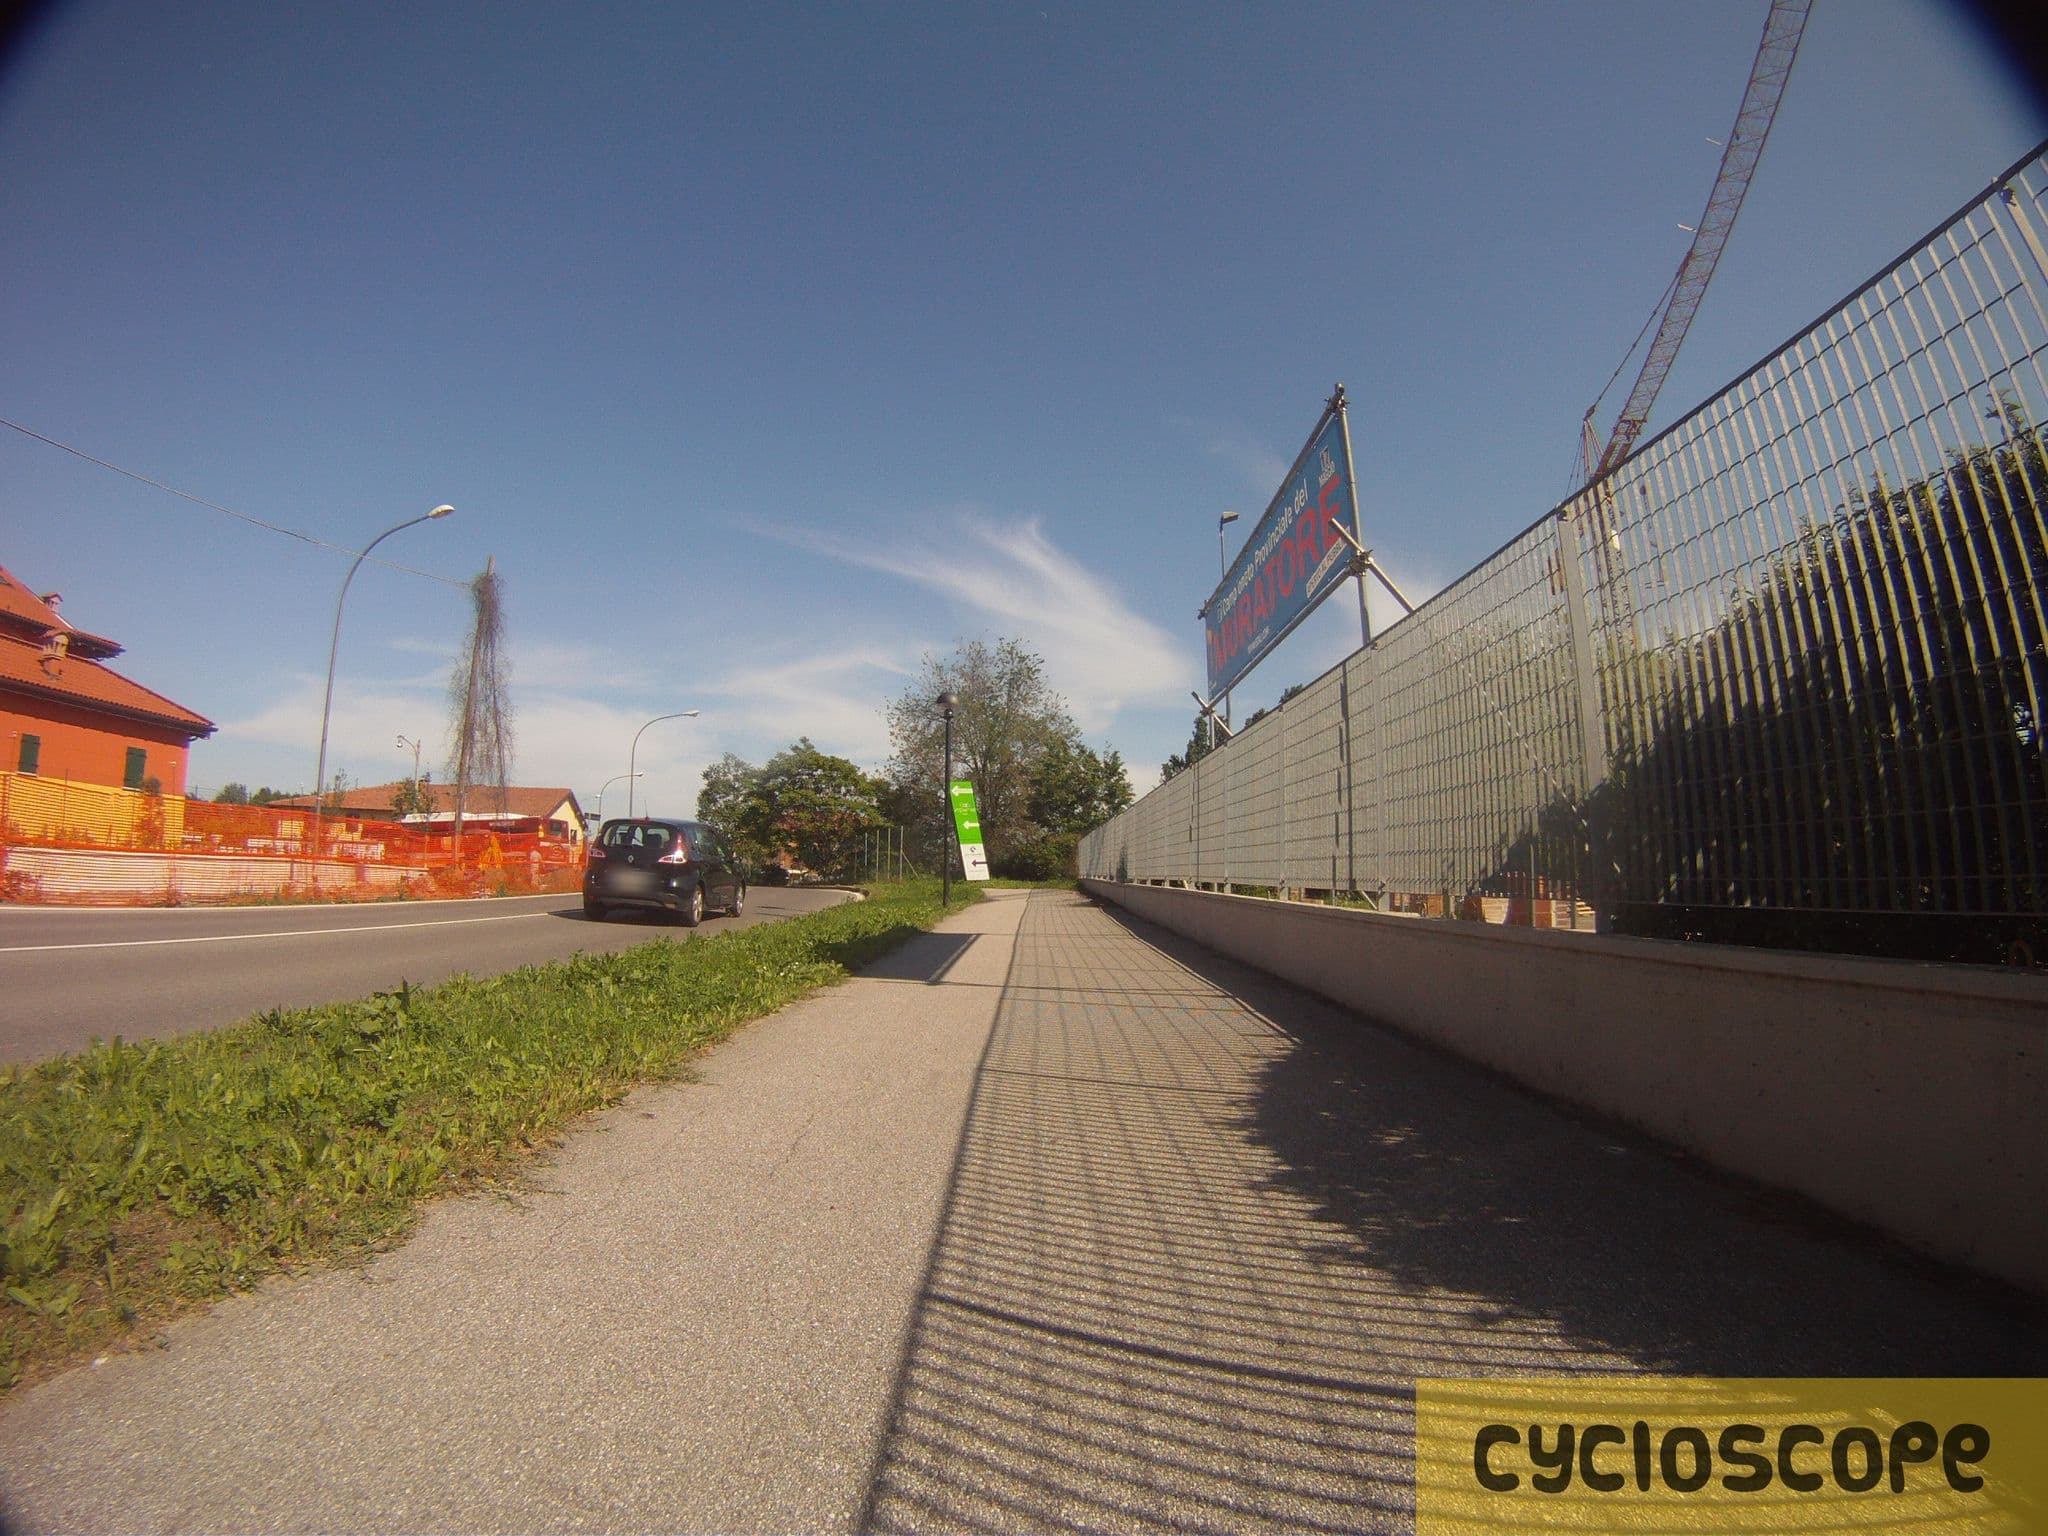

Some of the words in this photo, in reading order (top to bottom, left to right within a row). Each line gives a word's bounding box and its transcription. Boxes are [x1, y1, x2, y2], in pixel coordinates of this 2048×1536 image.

[1209, 475, 1341, 676] MURATORE
[1254, 504, 1293, 572] Provinciale
[1293, 478, 1309, 516] del
